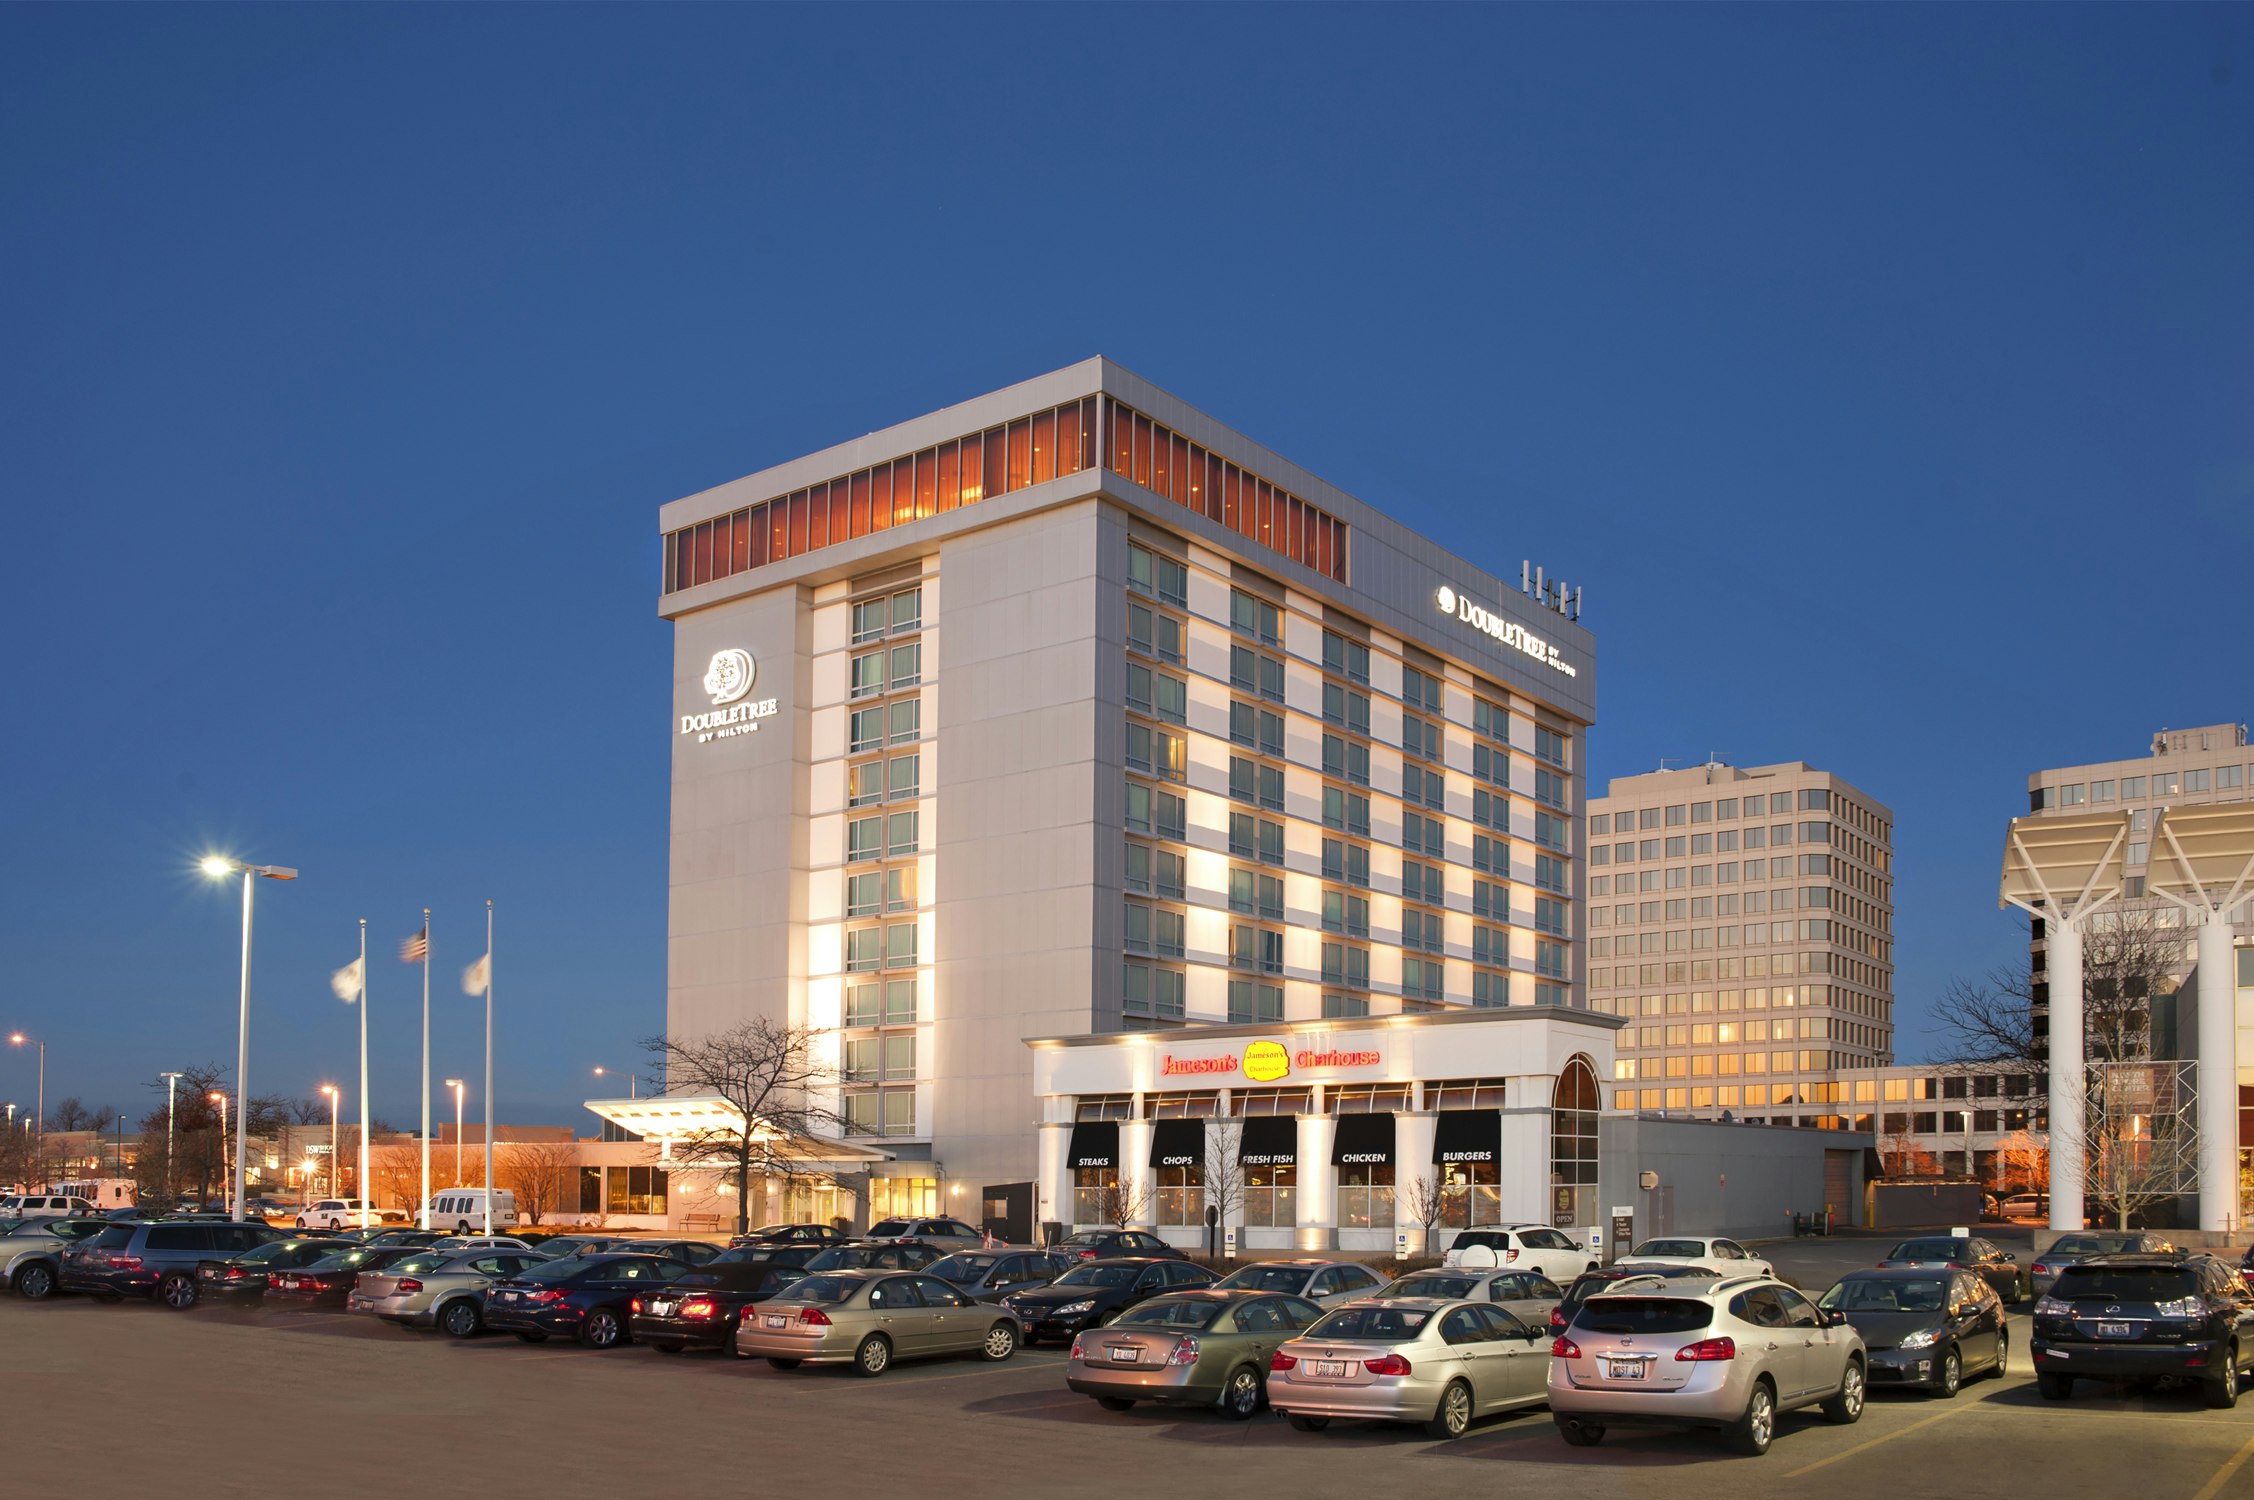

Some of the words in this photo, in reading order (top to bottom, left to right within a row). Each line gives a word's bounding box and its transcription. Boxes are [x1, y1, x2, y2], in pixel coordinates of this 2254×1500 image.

[1548, 645, 1560, 658] BY
[1548, 655, 1576, 677] HILTON
[698, 732, 714, 743] BY
[717, 722, 759, 739] HILTON
[1246, 1050, 1284, 1060] Jameson's
[1161, 1053, 1238, 1076] Jameson's
[1295, 1049, 1381, 1069] Charhouse
[1162, 1156, 1194, 1165] CHOPS
[1242, 1155, 1271, 1164] FRESH
[1272, 1154, 1294, 1163] FISH
[1341, 1153, 1386, 1163] CHICKEN
[1442, 1151, 1492, 1161] BURGERS
[1078, 1157, 1110, 1166] STEAKS
[1555, 1215, 1573, 1223] OPEN
